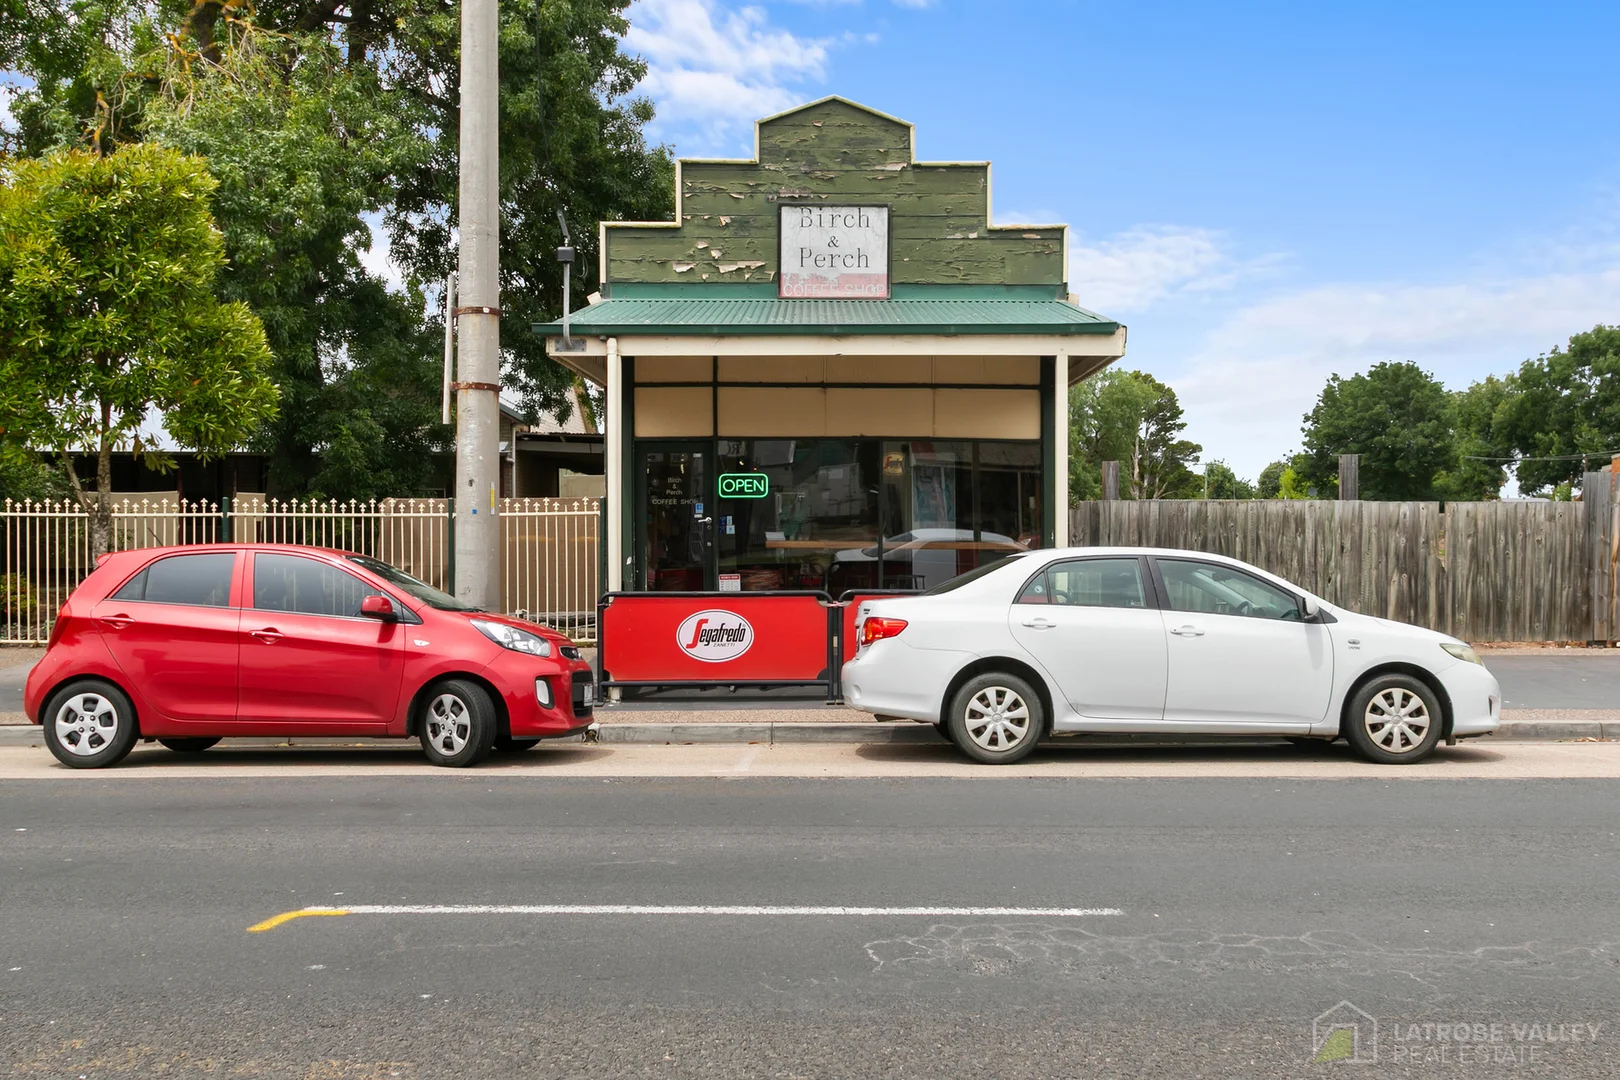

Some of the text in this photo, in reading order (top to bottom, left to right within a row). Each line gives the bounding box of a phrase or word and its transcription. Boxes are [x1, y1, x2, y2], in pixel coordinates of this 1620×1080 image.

[799, 206, 870, 229] Birch
[827, 235, 840, 248] &
[799, 247, 870, 268] Perch
[783, 283, 885, 297] COFFEE SHOP
[667, 476, 683, 484] Birch
[722, 478, 765, 493] OPEN
[685, 618, 747, 649] Segafredo
